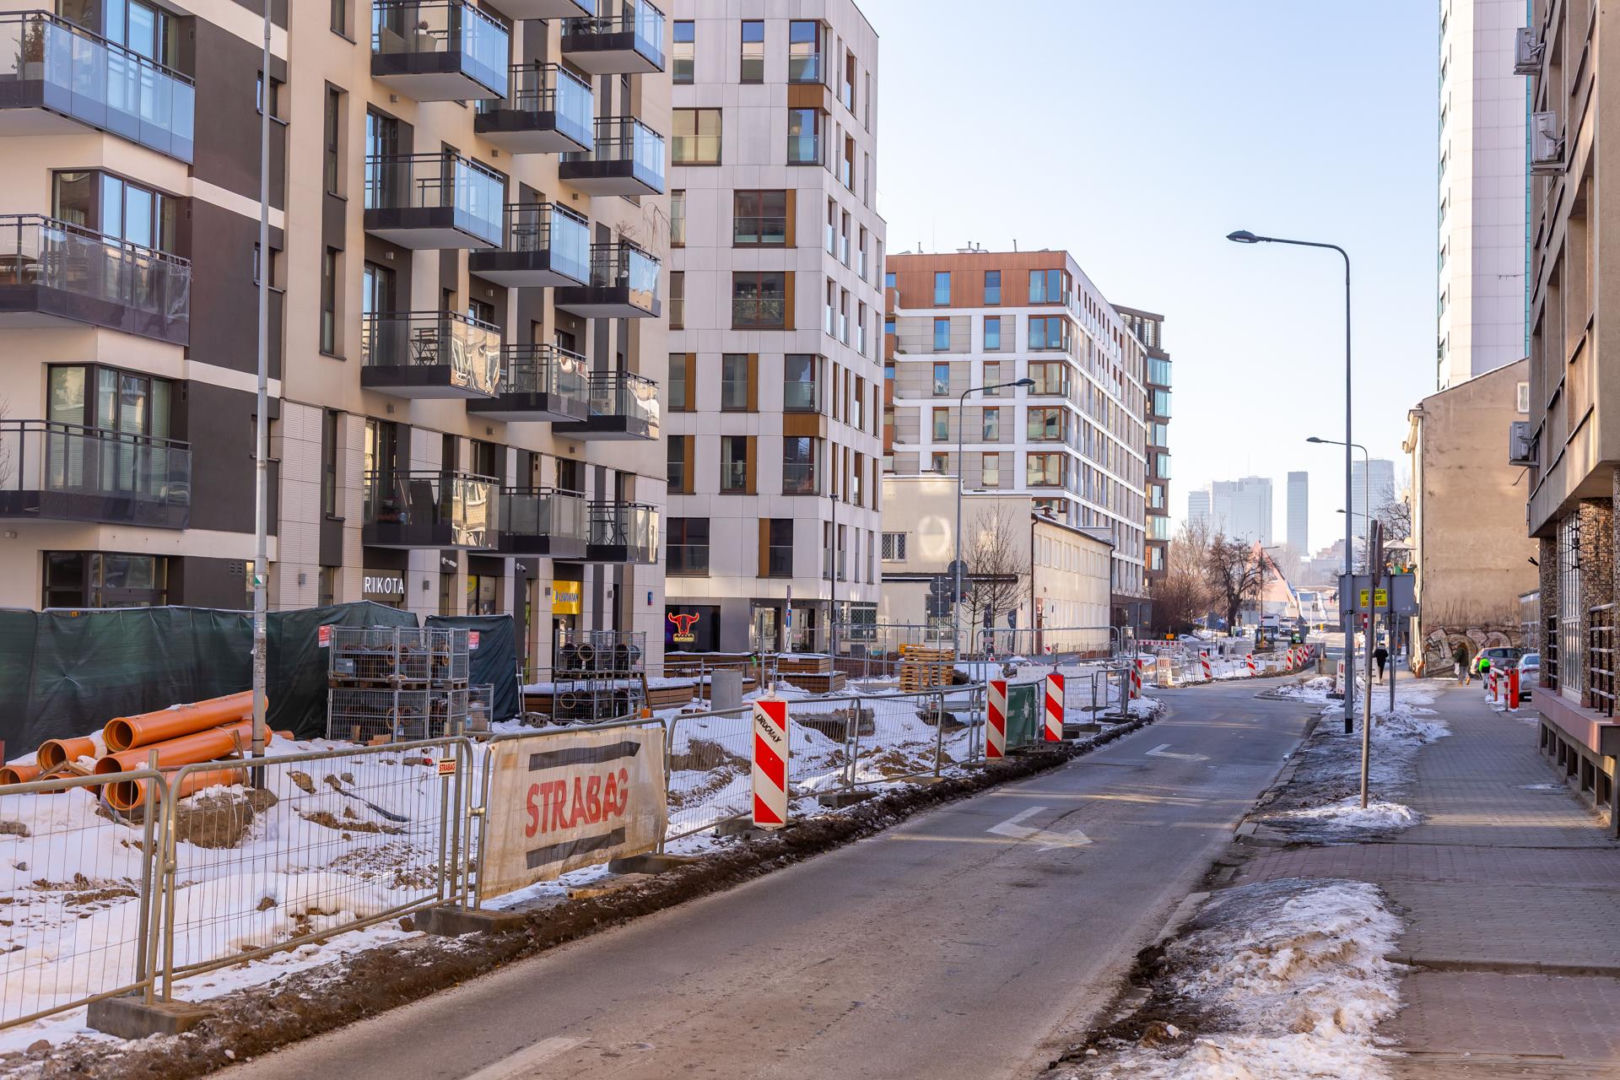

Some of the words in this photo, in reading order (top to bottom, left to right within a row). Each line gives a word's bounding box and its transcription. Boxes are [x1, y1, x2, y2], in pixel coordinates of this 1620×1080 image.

[364, 576, 405, 594] RIKOTA
[438, 762, 456, 772] STRABAG
[525, 767, 628, 838] STRABAG
